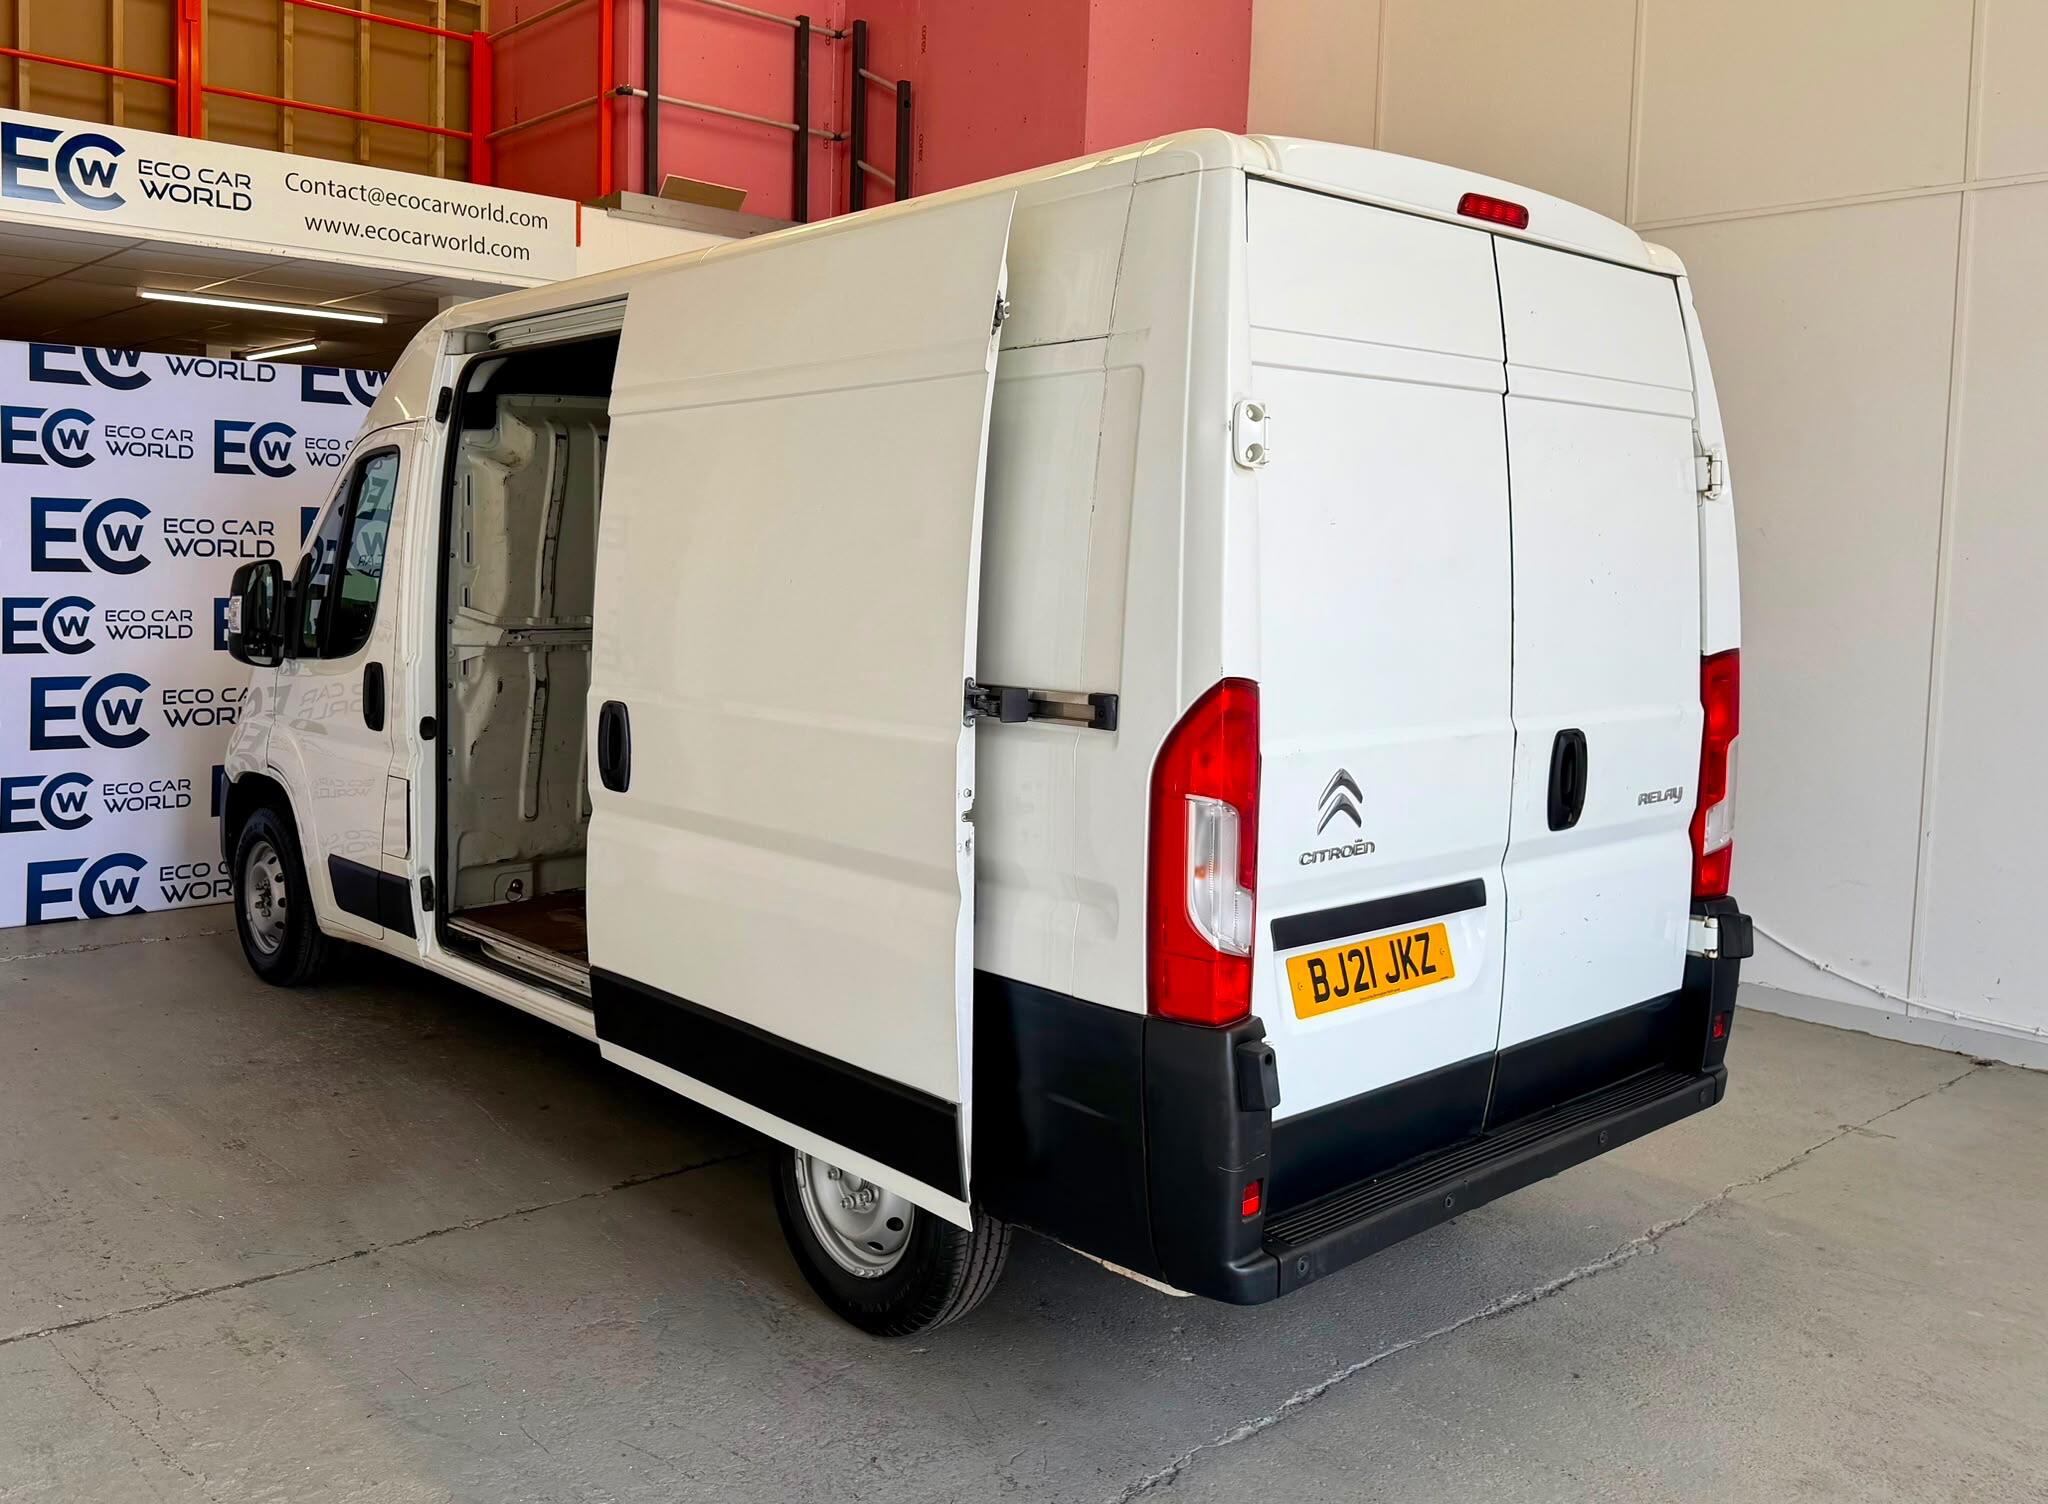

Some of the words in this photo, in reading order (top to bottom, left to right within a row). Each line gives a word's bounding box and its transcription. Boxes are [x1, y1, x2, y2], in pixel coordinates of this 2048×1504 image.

[138, 159, 191, 180] ECO
[198, 168, 252, 190] CAR
[139, 178, 252, 212] WORLD
[285, 172, 548, 230] Contact@ecocarworld.com
[304, 215, 530, 260] www.ecocarworld.com
[165, 355, 276, 383] WORLD
[104, 424, 145, 440] ECO
[151, 427, 194, 443] CAR
[105, 440, 194, 460] WORLD
[304, 437, 341, 451] ECO
[163, 517, 214, 535] ECO
[221, 520, 275, 536] CAR
[164, 537, 275, 559] WORLD
[104, 609, 145, 623] ECO
[151, 609, 193, 622] CAR
[105, 624, 193, 641] WORLD
[162, 688, 215, 705] ECO
[102, 781, 144, 796] ECO
[148, 778, 192, 793] CAR
[1637, 786, 1683, 806] RELAY
[103, 793, 192, 814] WORLD
[1299, 838, 1376, 866] CITROËN
[159, 862, 211, 881] ECO
[1307, 947, 1377, 1003] BJ21
[1385, 931, 1437, 984] JKZ
